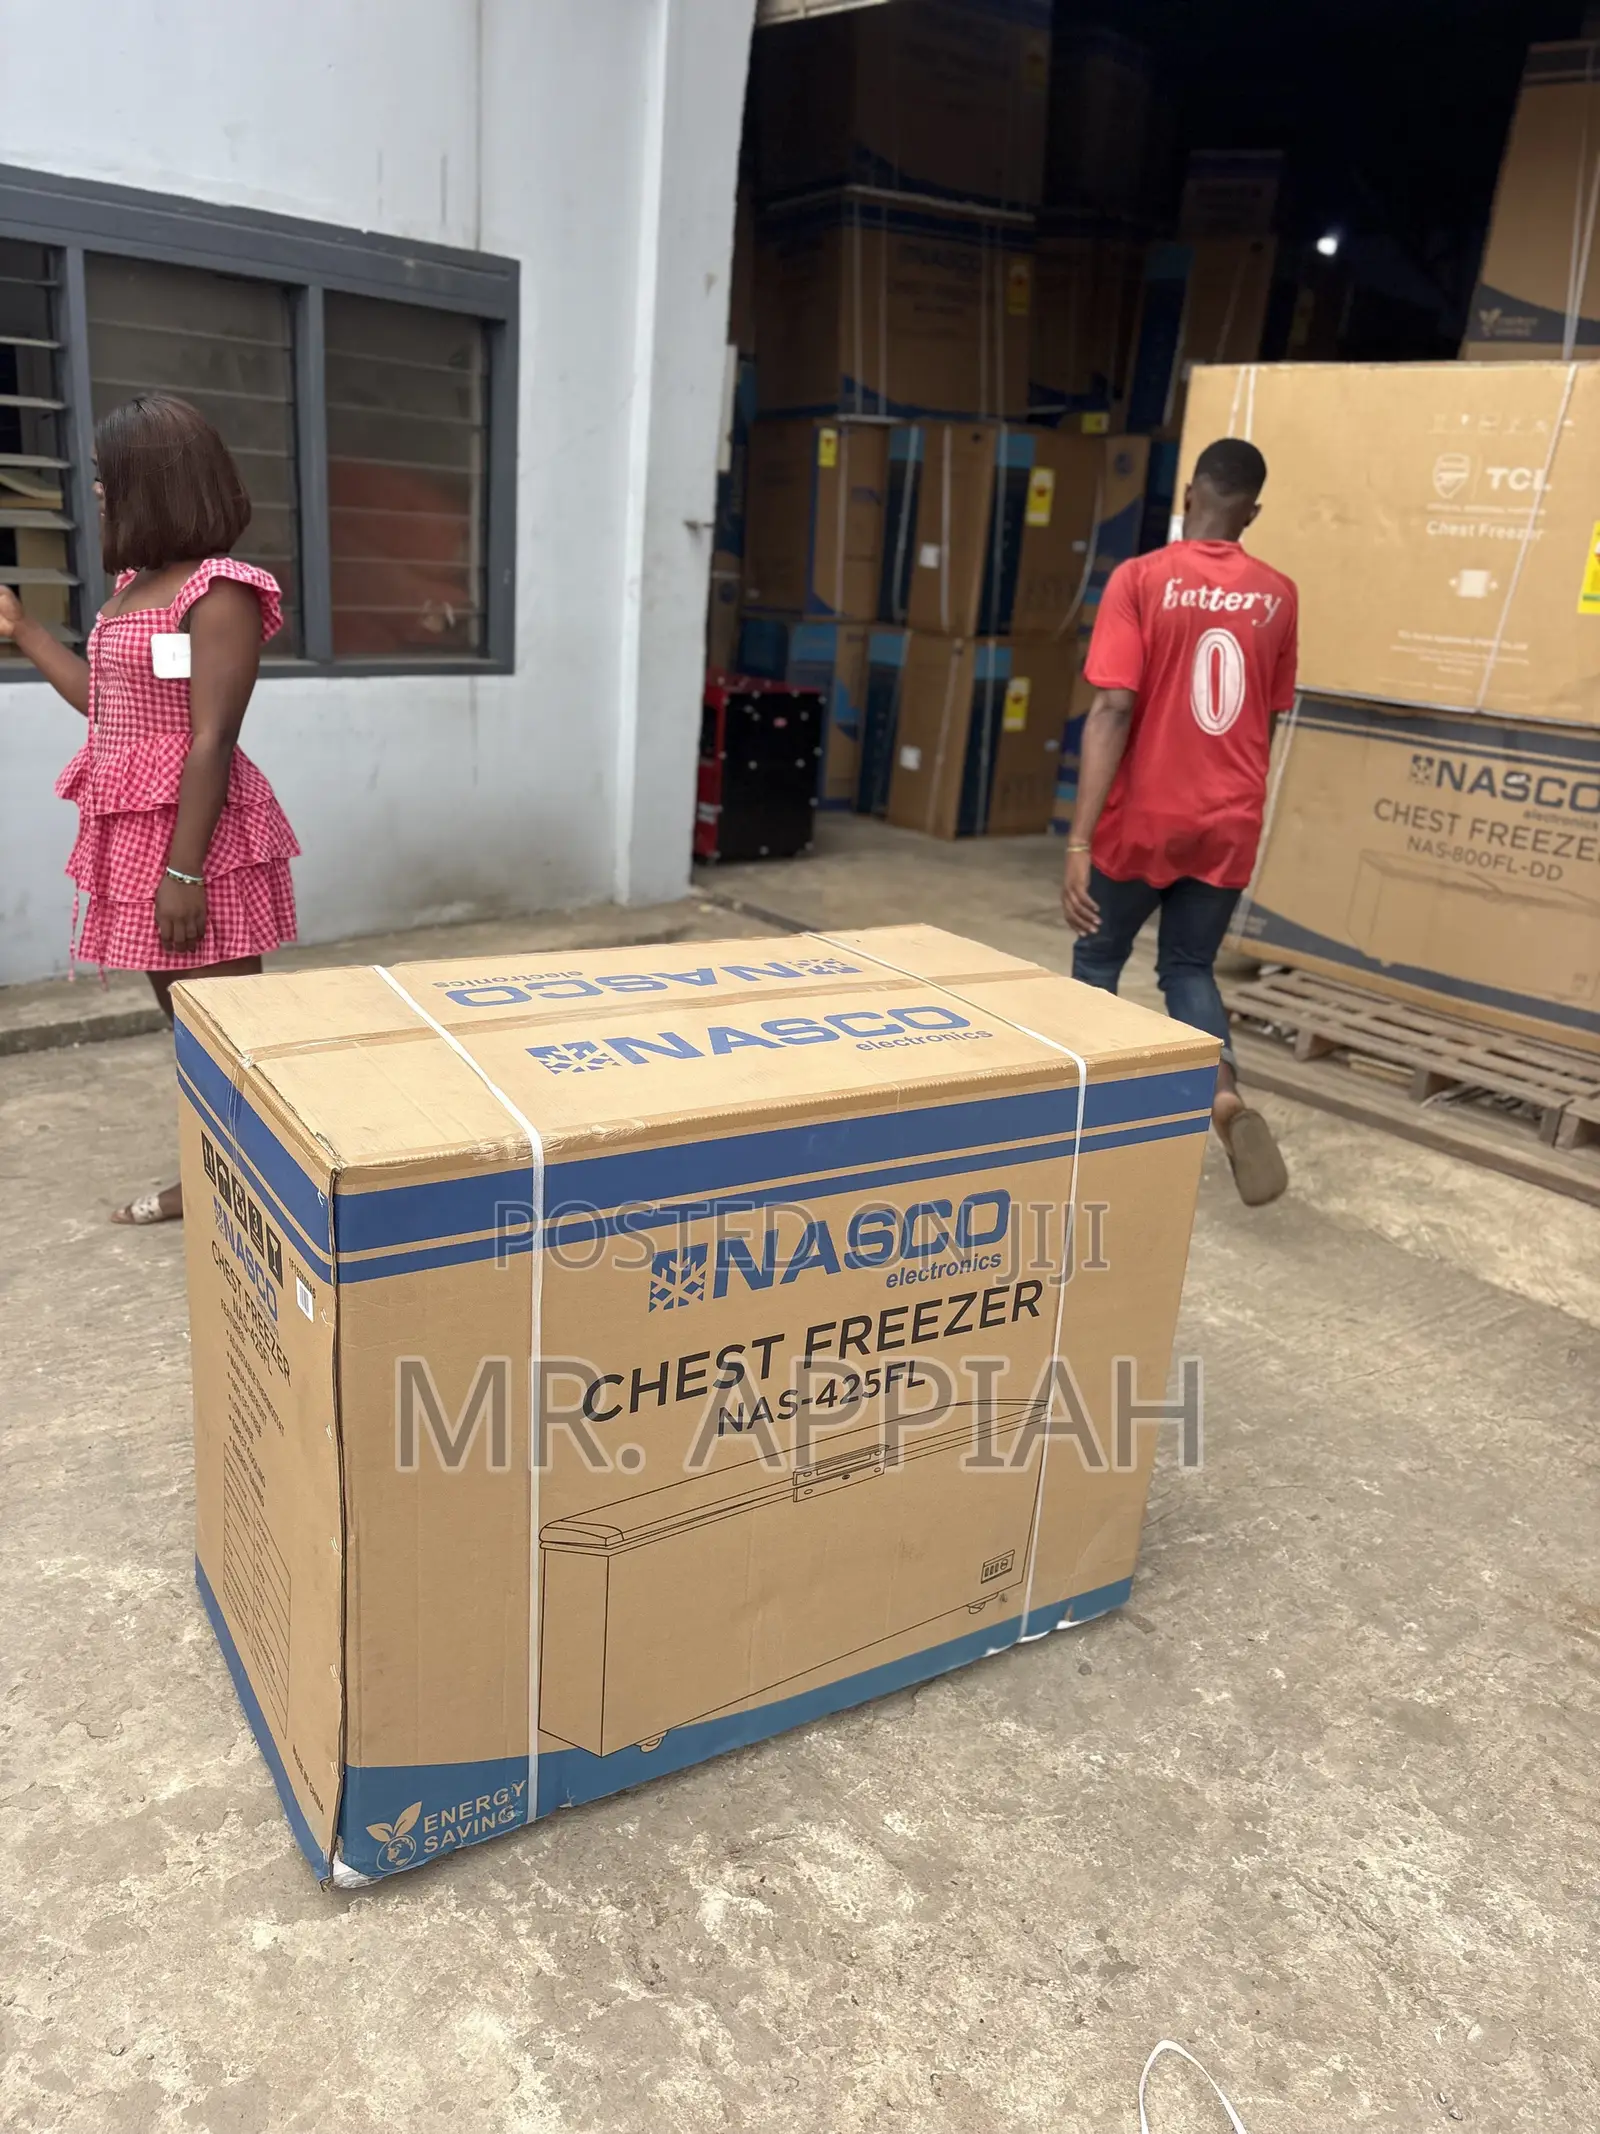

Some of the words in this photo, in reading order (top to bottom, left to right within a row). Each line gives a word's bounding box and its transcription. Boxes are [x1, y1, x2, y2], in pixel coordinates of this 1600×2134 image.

[1485, 467, 1552, 492] TCL
[1426, 519, 1475, 538] Chest
[1189, 627, 1246, 736] 0
[1436, 759, 1600, 814] NASCO
[1373, 798, 1462, 836] CHEST
[1469, 817, 1600, 863] FREEZE
[1522, 808, 1599, 832] electronics
[1406, 835, 1564, 882] NAS-800FL-DD
[432, 969, 584, 989] electronics
[445, 961, 805, 1007] NASCO
[602, 1006, 971, 1065] NASCO
[855, 1029, 994, 1051] electronics
[223, 1210, 278, 1322] NASCO
[713, 1189, 1011, 1299] NASCO
[885, 1252, 1002, 1289] electronics
[211, 1240, 241, 1302] CHEST
[245, 1289, 292, 1388] FREEZER
[233, 1296, 272, 1376] NAS-425FL
[582, 1334, 784, 1423] CHEST
[803, 1279, 1043, 1370] FREEZER
[717, 1360, 925, 1437] NAS-425FL
[424, 1779, 526, 1834] ENERGY
[424, 1804, 515, 1854] SAVING
